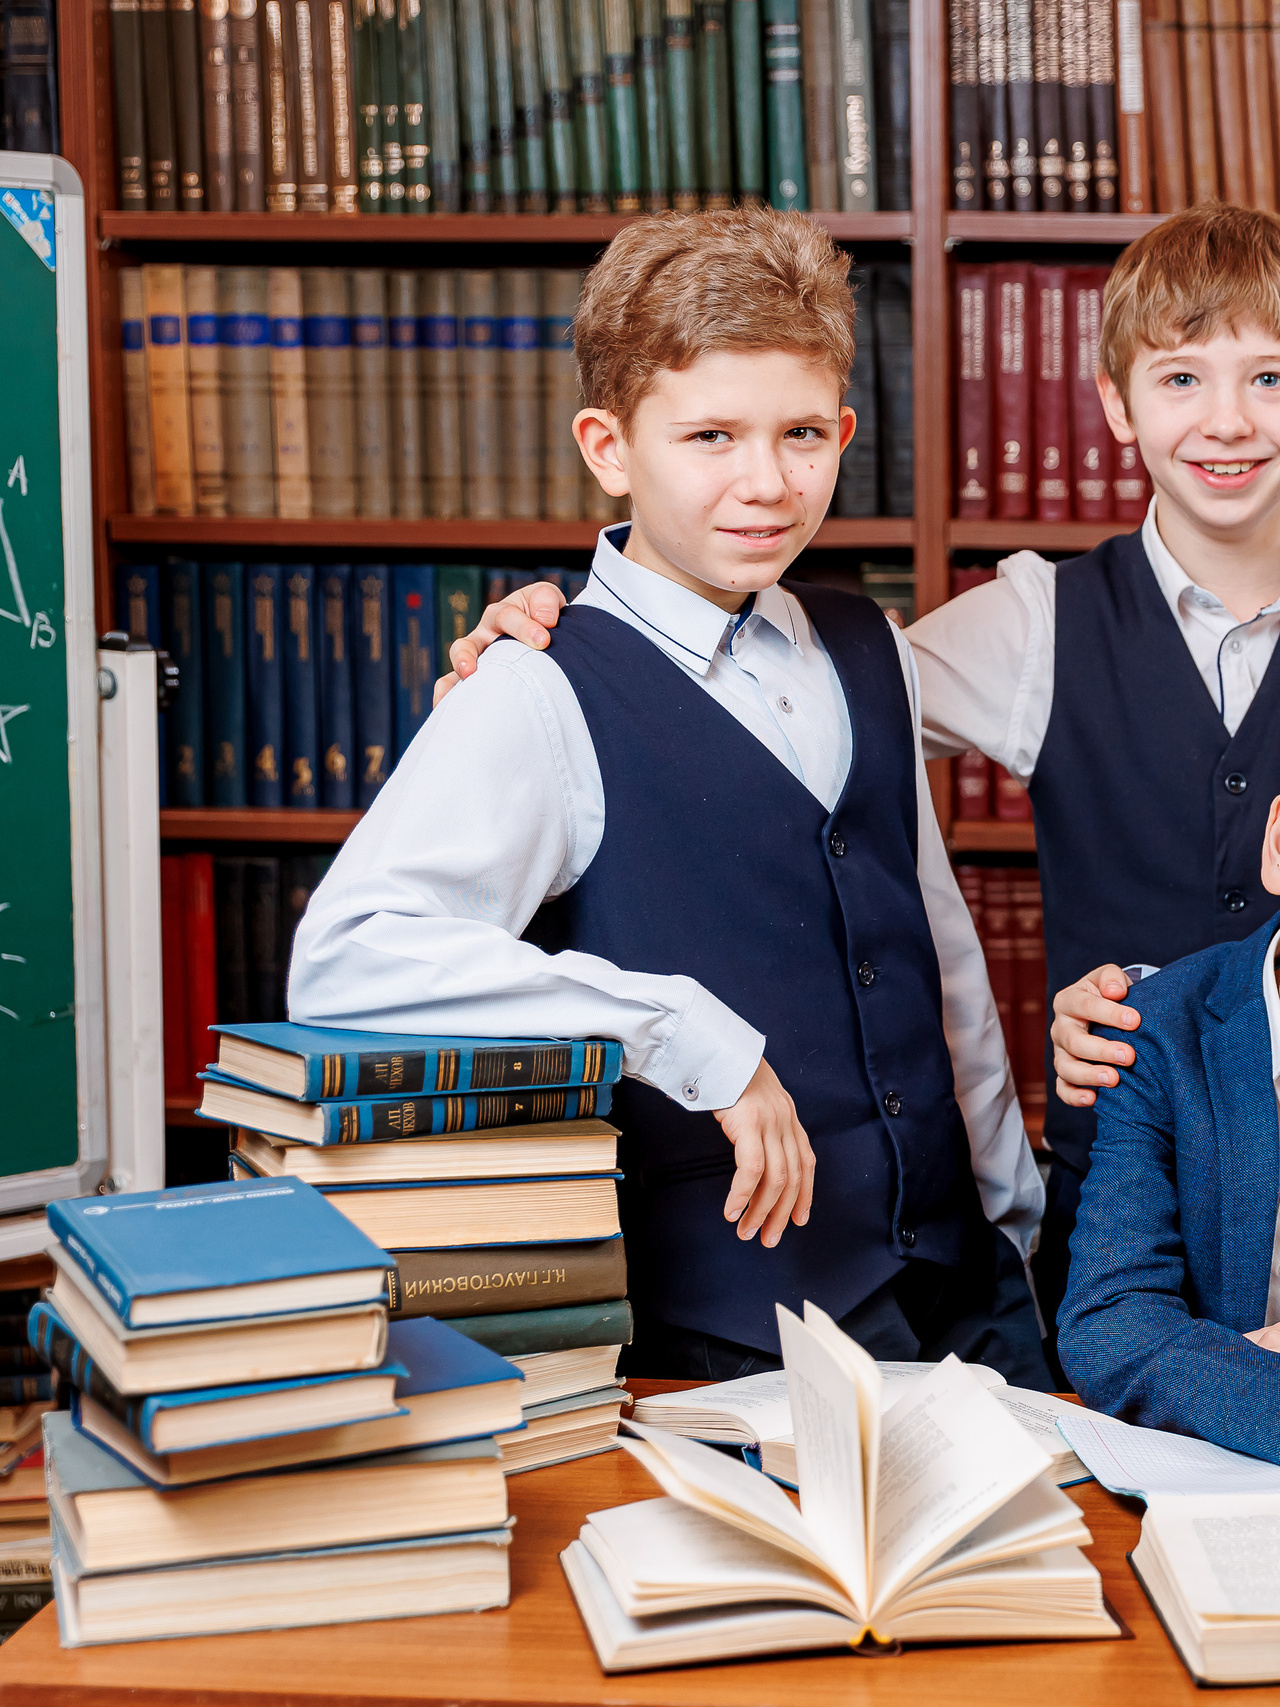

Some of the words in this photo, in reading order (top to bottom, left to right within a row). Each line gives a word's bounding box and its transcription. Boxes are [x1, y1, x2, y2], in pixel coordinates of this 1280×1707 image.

[1003, 440, 1021, 464] 2
[7, 455, 28, 496] A
[365, 745, 386, 780] 7
[389, 1055, 404, 1090] ЧЕХОВ
[513, 1061, 522, 1071] 8
[401, 1101, 415, 1136] ЧЕХОВ
[514, 1103, 523, 1111] 7
